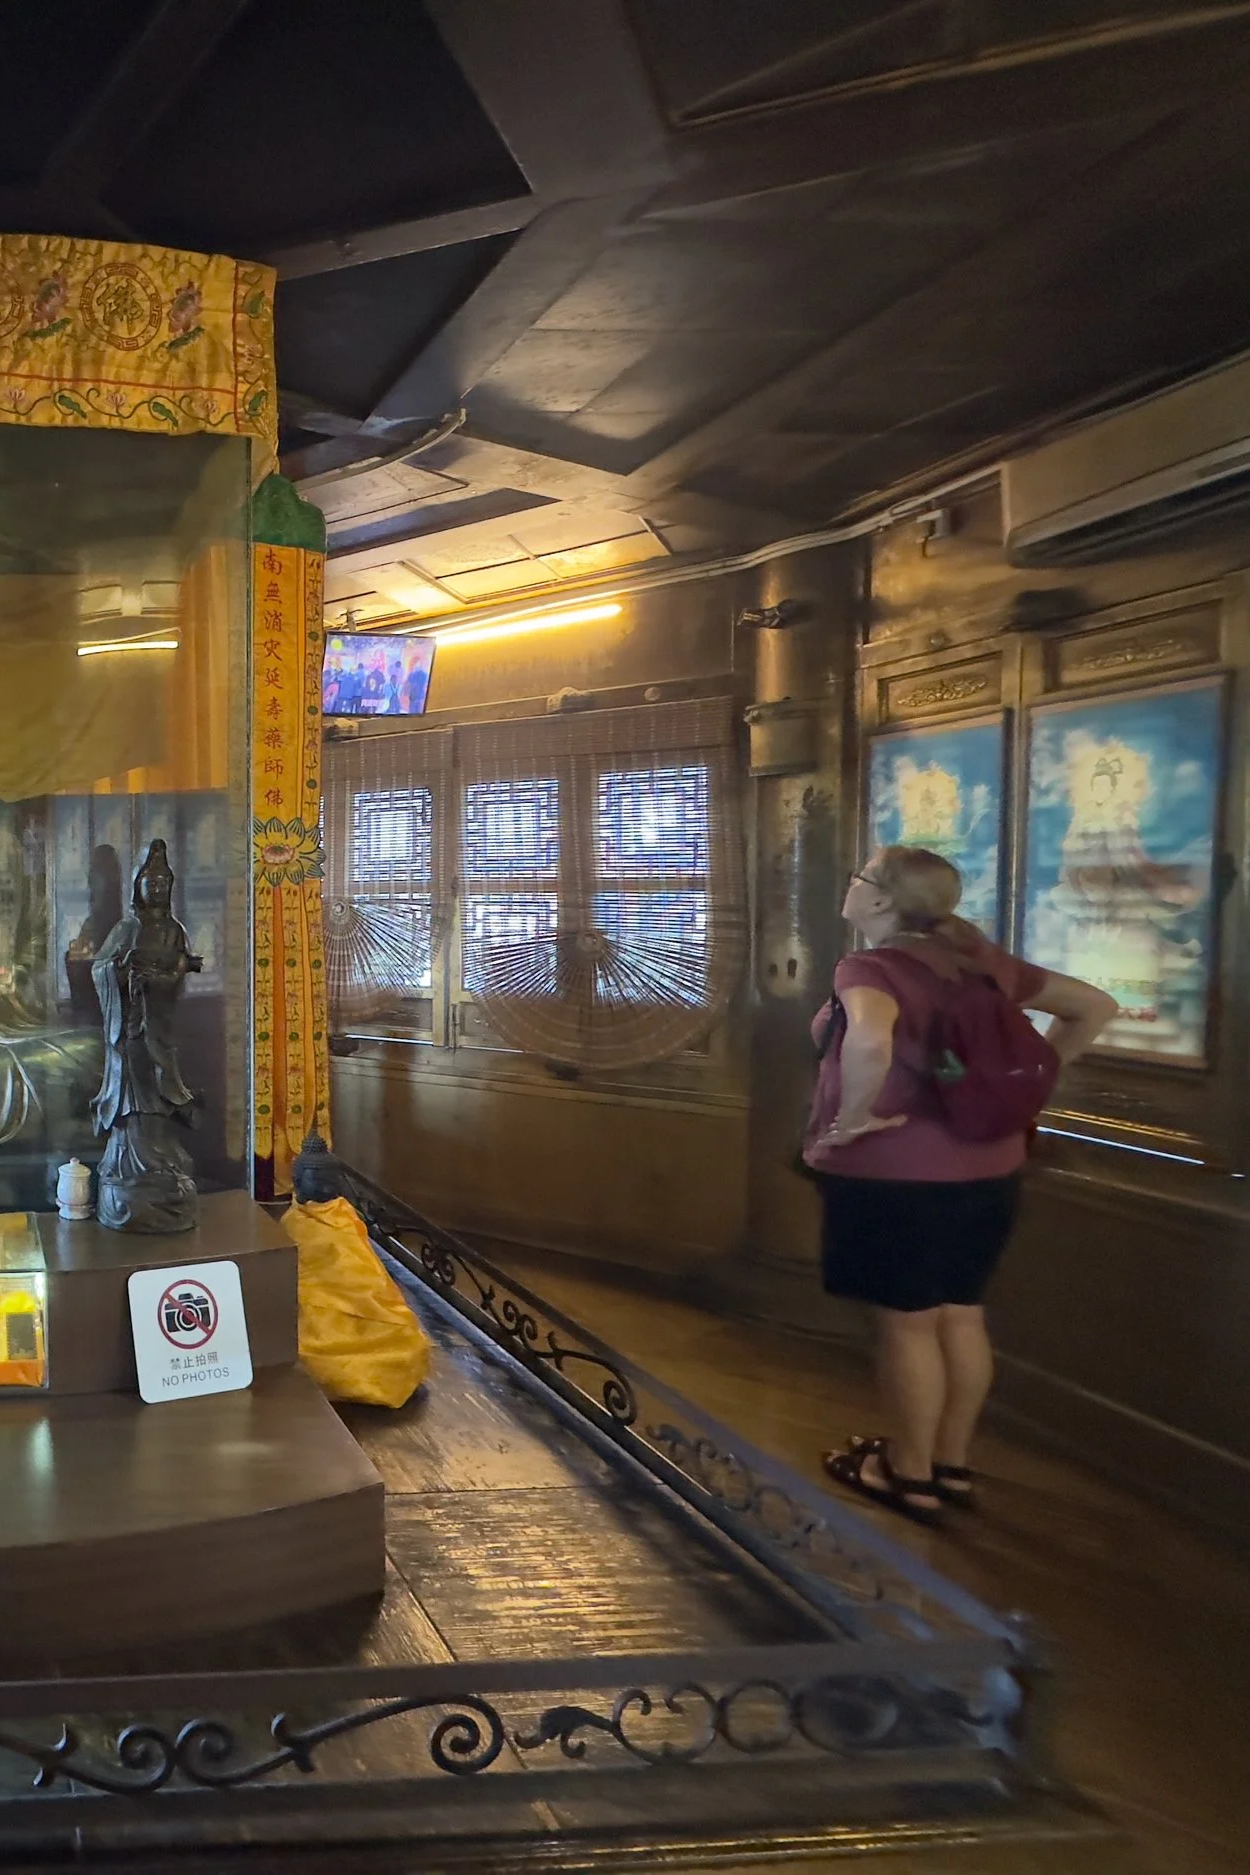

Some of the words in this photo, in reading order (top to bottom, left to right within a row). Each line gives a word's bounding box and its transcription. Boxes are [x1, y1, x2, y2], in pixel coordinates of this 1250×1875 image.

[170, 1351, 219, 1370] 禁止拍照
[162, 1375, 180, 1387] NO
[182, 1367, 230, 1383] PHOTOS
